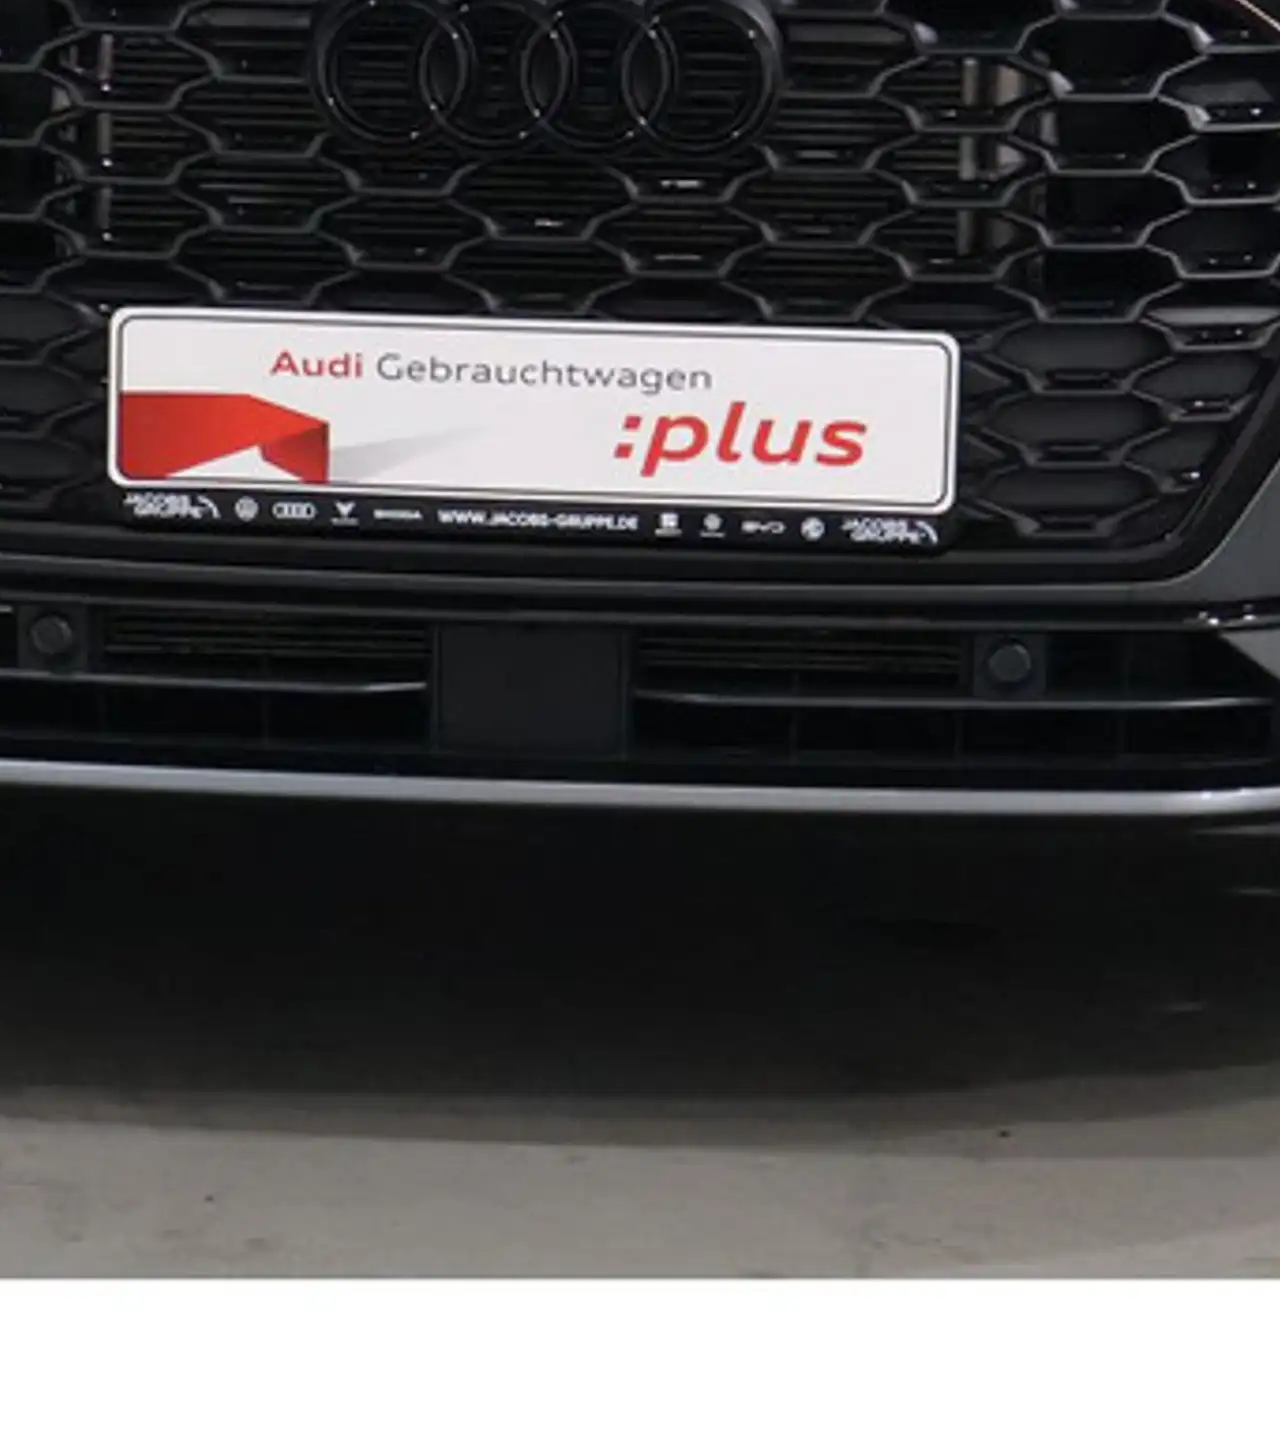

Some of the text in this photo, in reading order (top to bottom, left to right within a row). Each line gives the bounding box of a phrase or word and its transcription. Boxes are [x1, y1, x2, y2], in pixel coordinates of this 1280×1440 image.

[272, 350, 713, 395] Audi Gebrauchtwagen
[613, 400, 866, 478] :plus
